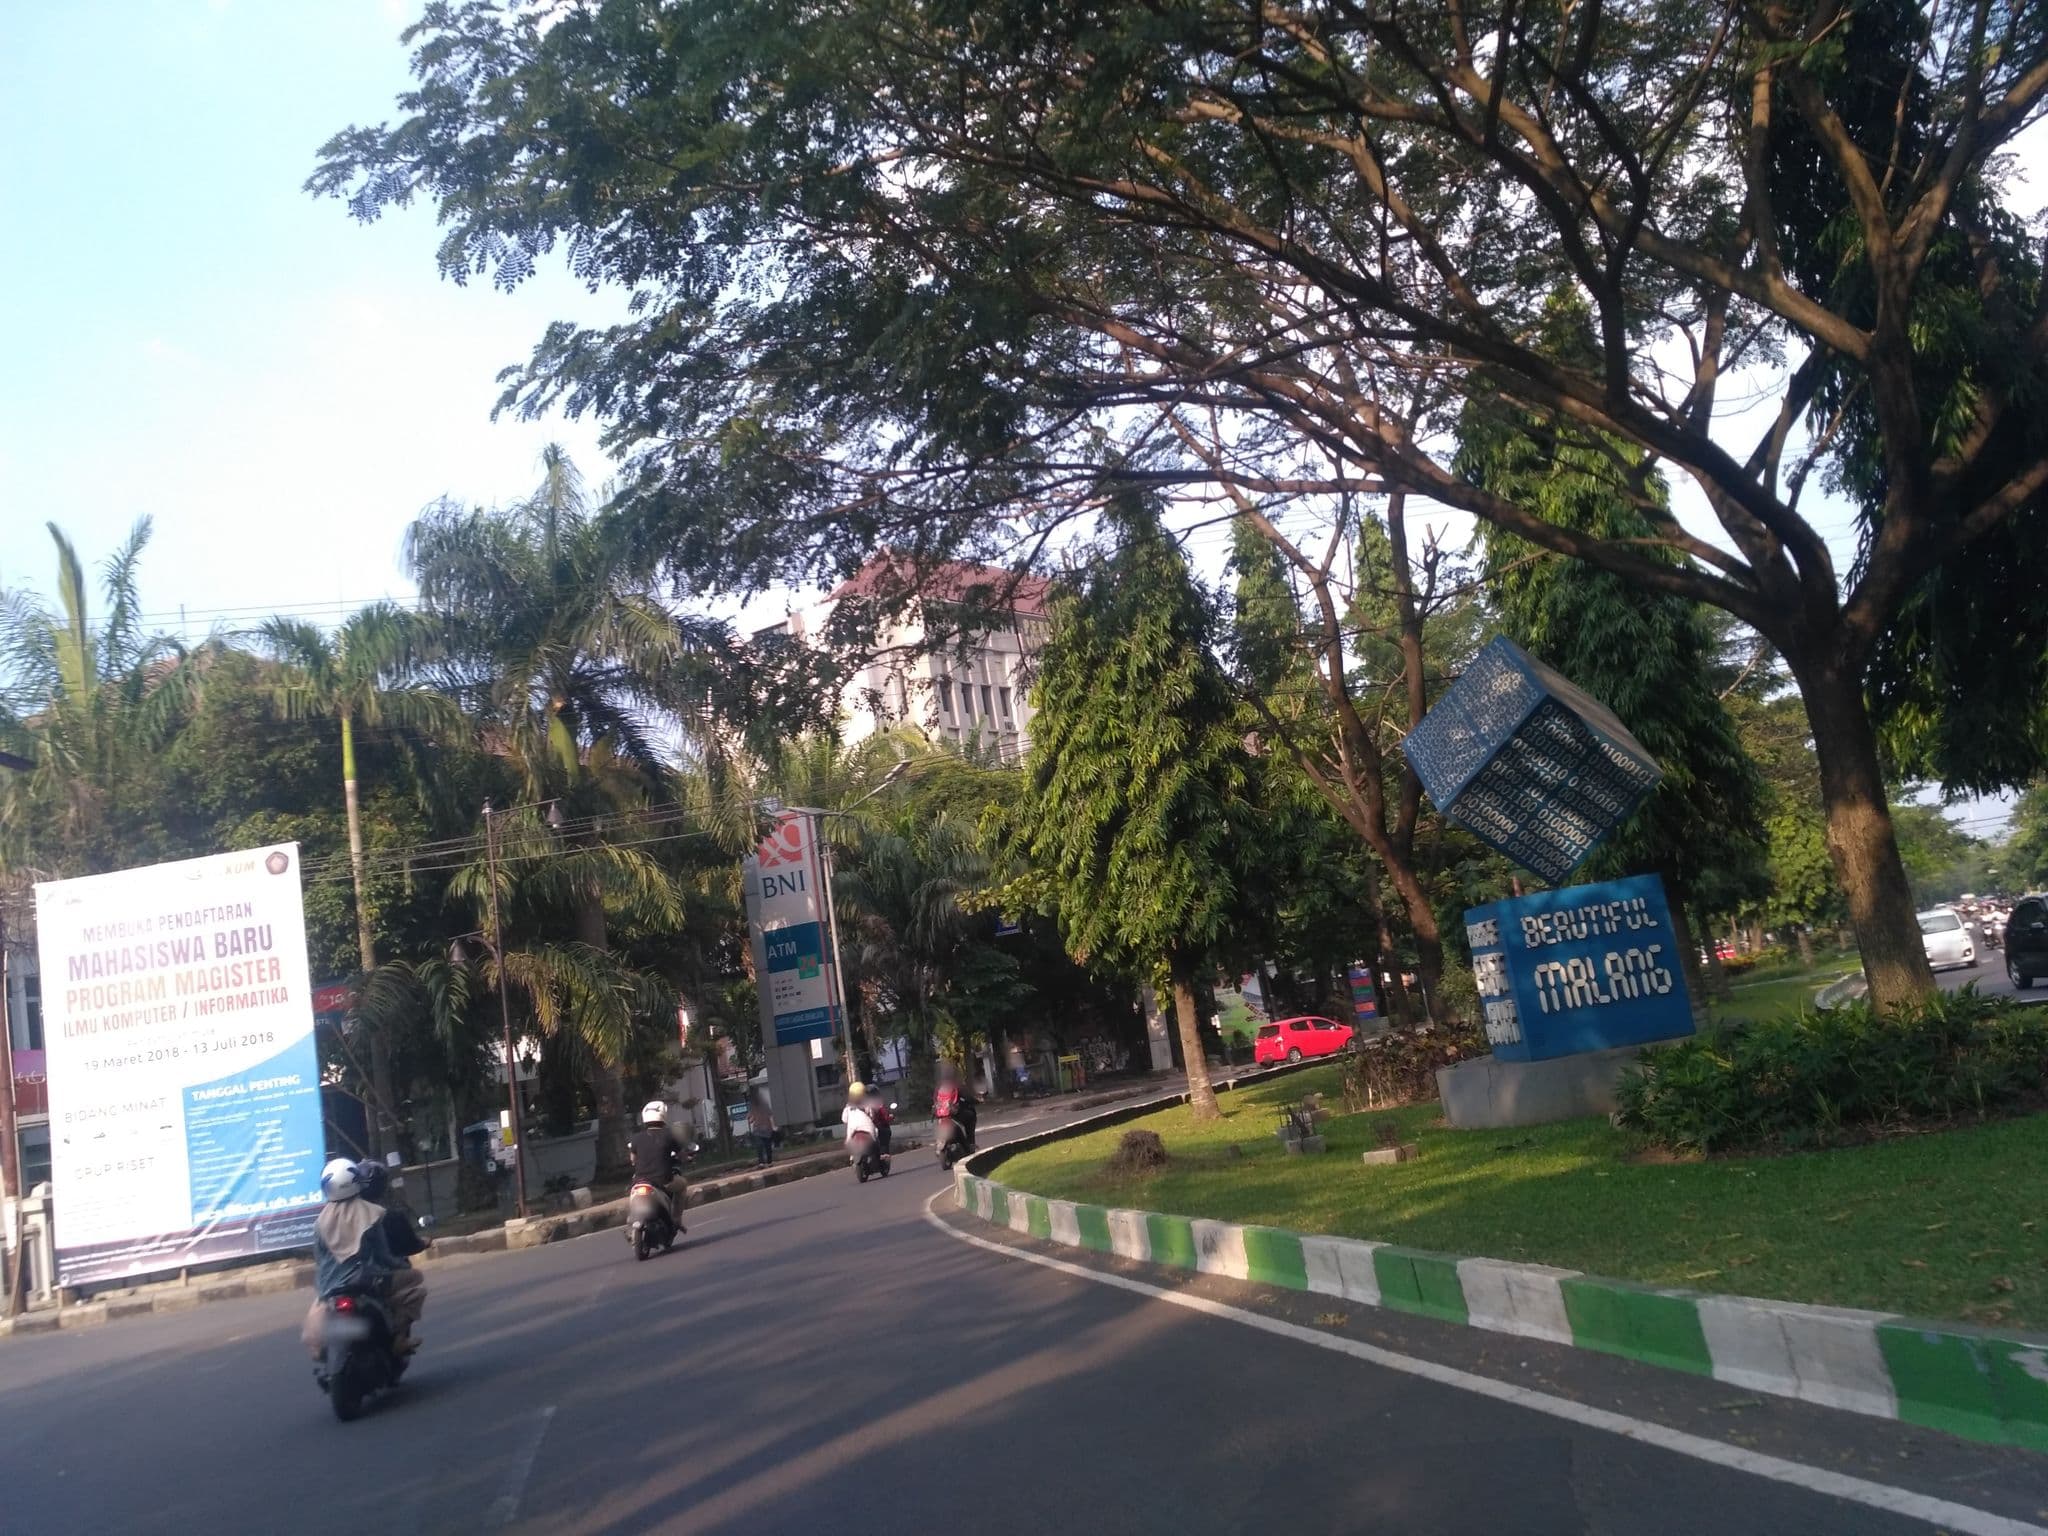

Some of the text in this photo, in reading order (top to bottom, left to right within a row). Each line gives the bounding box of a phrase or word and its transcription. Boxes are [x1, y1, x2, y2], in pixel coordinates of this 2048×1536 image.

[761, 869, 806, 899] BNI
[83, 902, 253, 943] MEMBUKA PENDAFTARAN
[1519, 898, 1659, 948] BEAUTIFUL
[68, 924, 273, 982] MAHASISWA BARU
[768, 940, 797, 959] ATM
[66, 956, 281, 1014] PROGRAM MAGISTER
[1533, 944, 1672, 1014] MALANG
[63, 1013, 98, 1039] ILMU
[103, 1003, 178, 1030] KOMPUTER
[181, 1001, 189, 1021] /
[194, 986, 289, 1016] INFORMATIKA
[104, 1054, 143, 1068] Maret
[147, 1047, 180, 1062] 2018
[191, 1042, 209, 1056] 13
[212, 1037, 238, 1053] Juli
[240, 1030, 275, 1048] 2018
[121, 1097, 167, 1113] MINAT
[191, 1083, 248, 1101] TANGGAL
